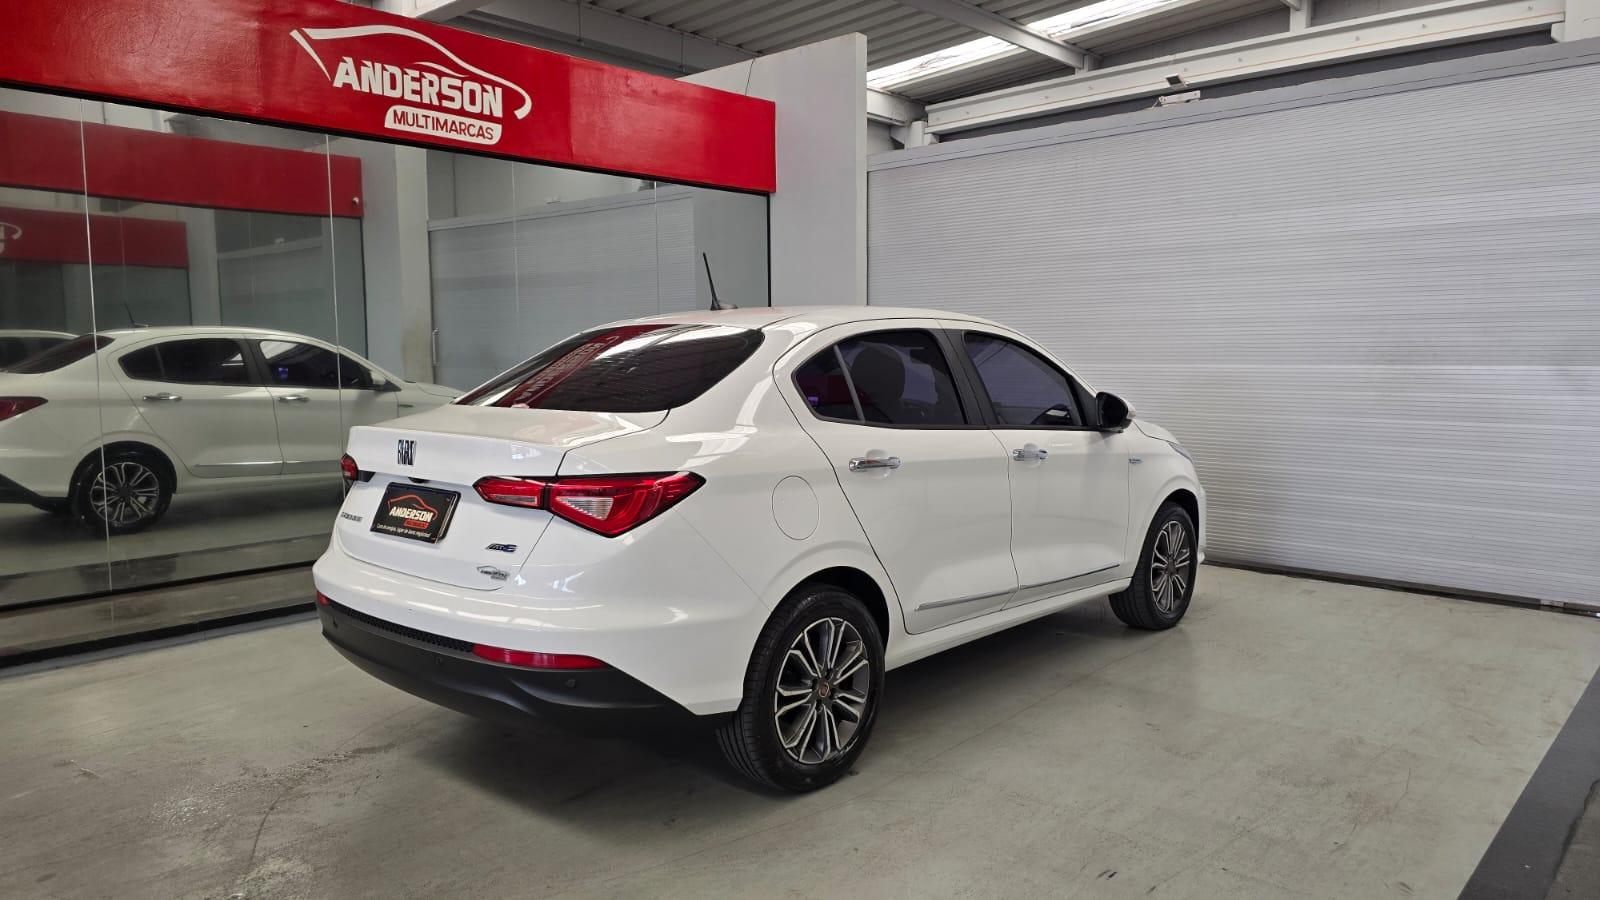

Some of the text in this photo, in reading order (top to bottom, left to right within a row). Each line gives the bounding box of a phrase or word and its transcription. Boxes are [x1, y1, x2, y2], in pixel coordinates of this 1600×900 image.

[333, 56, 503, 118] ANDERSON
[393, 109, 494, 140] MULTIMARCAS
[389, 506, 433, 522] ANDERSON
